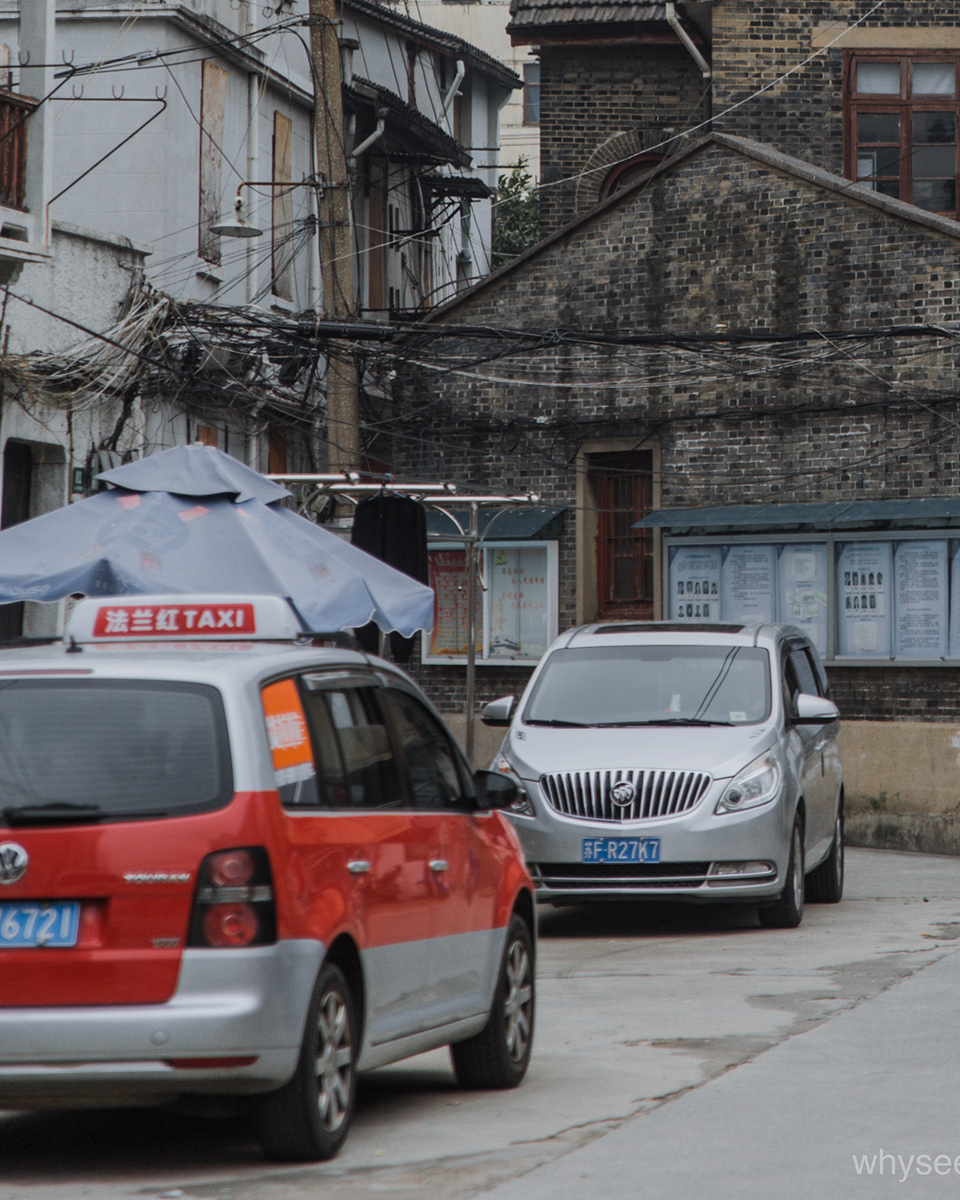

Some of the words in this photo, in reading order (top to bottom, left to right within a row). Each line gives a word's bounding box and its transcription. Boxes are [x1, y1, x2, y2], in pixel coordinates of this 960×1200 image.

[105, 608, 181, 633] 法兰红
[184, 609, 244, 629] TAXI
[0, 907, 71, 940] 6721
